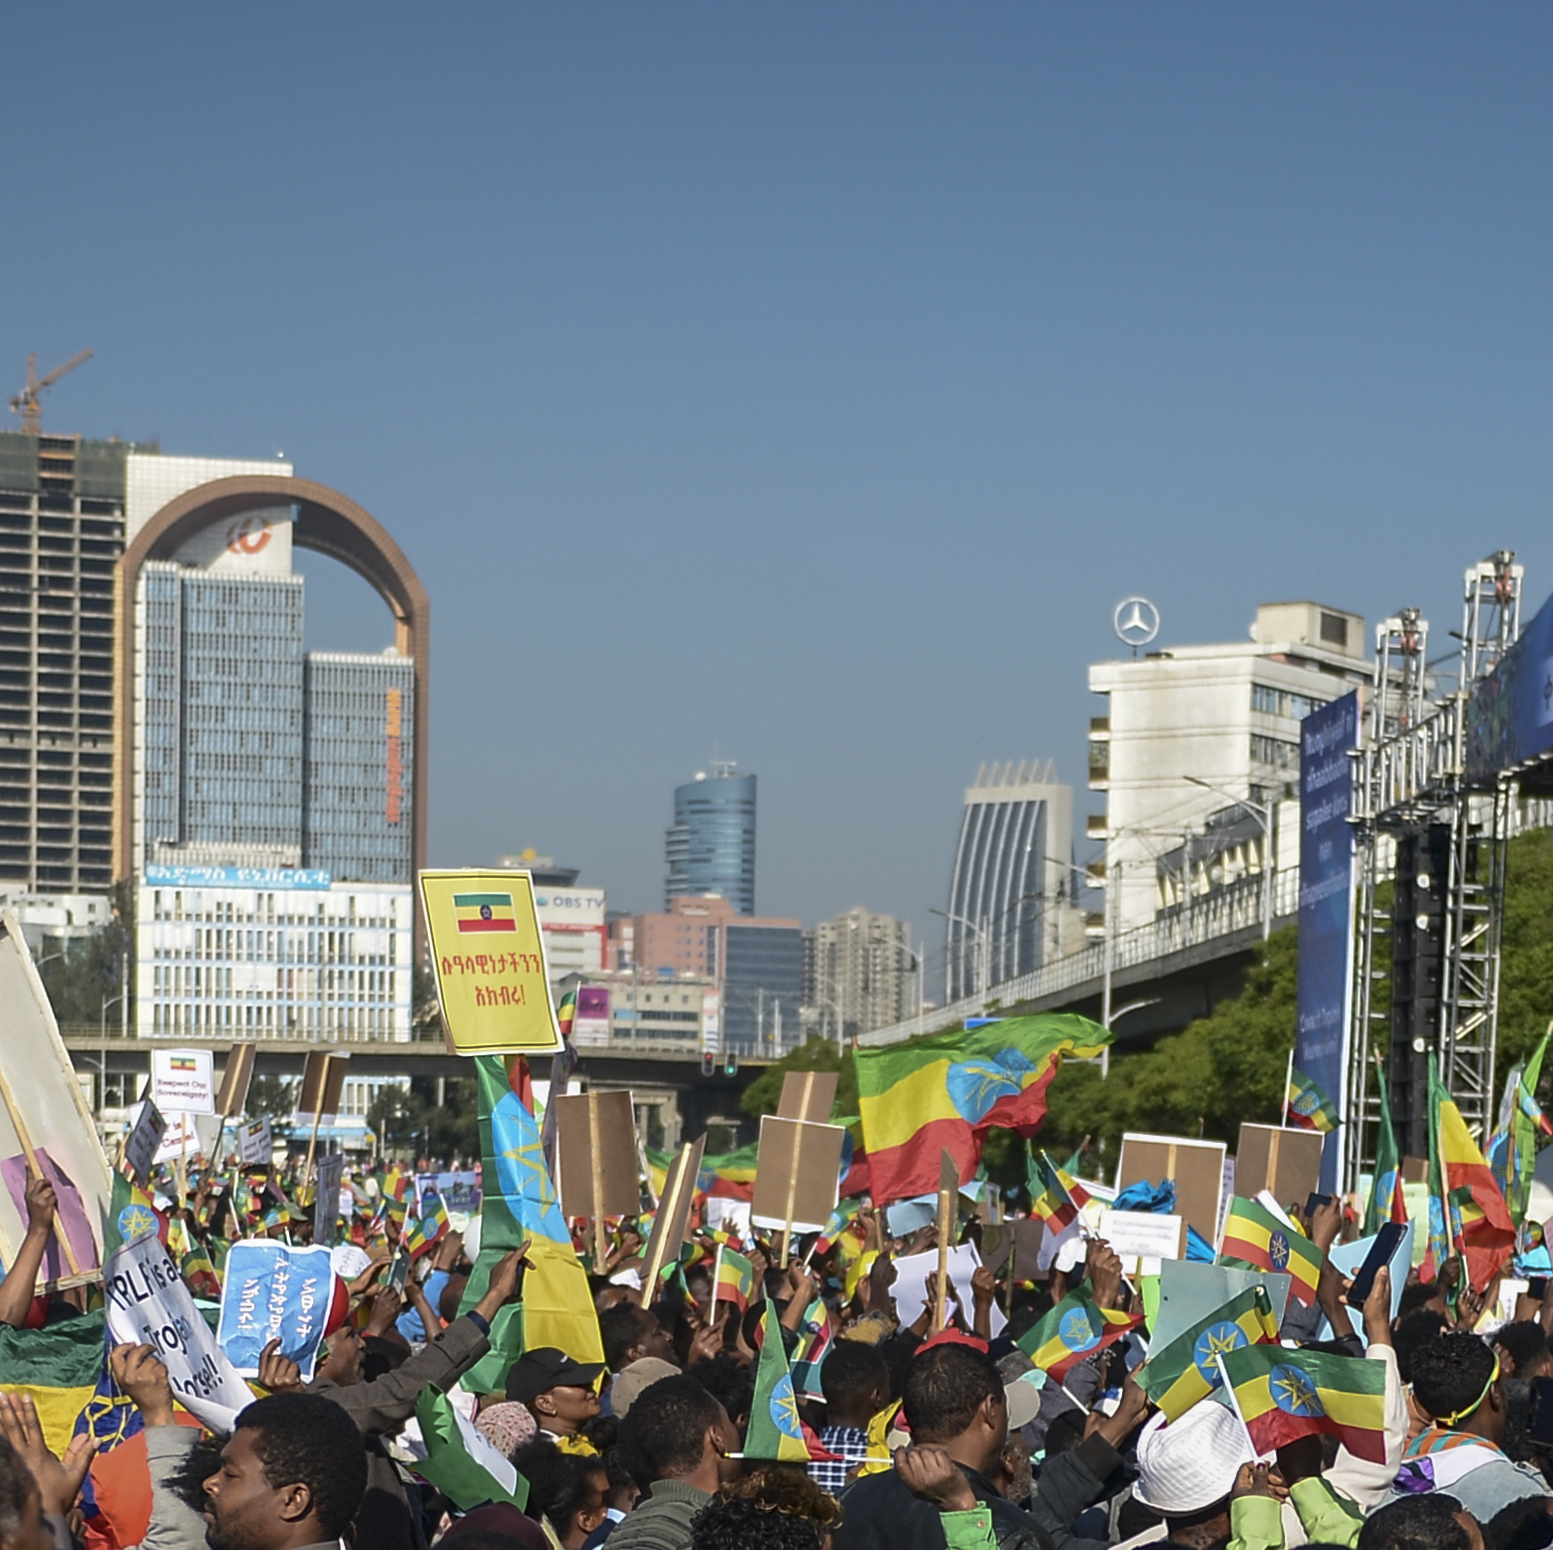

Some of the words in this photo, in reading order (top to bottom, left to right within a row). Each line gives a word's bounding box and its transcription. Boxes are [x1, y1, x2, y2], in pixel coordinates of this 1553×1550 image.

[553, 896, 582, 908] OBS
[587, 897, 605, 908] TV
[106, 1262, 154, 1311] TPLF
[145, 1257, 167, 1290] is
[165, 1257, 178, 1283] a
